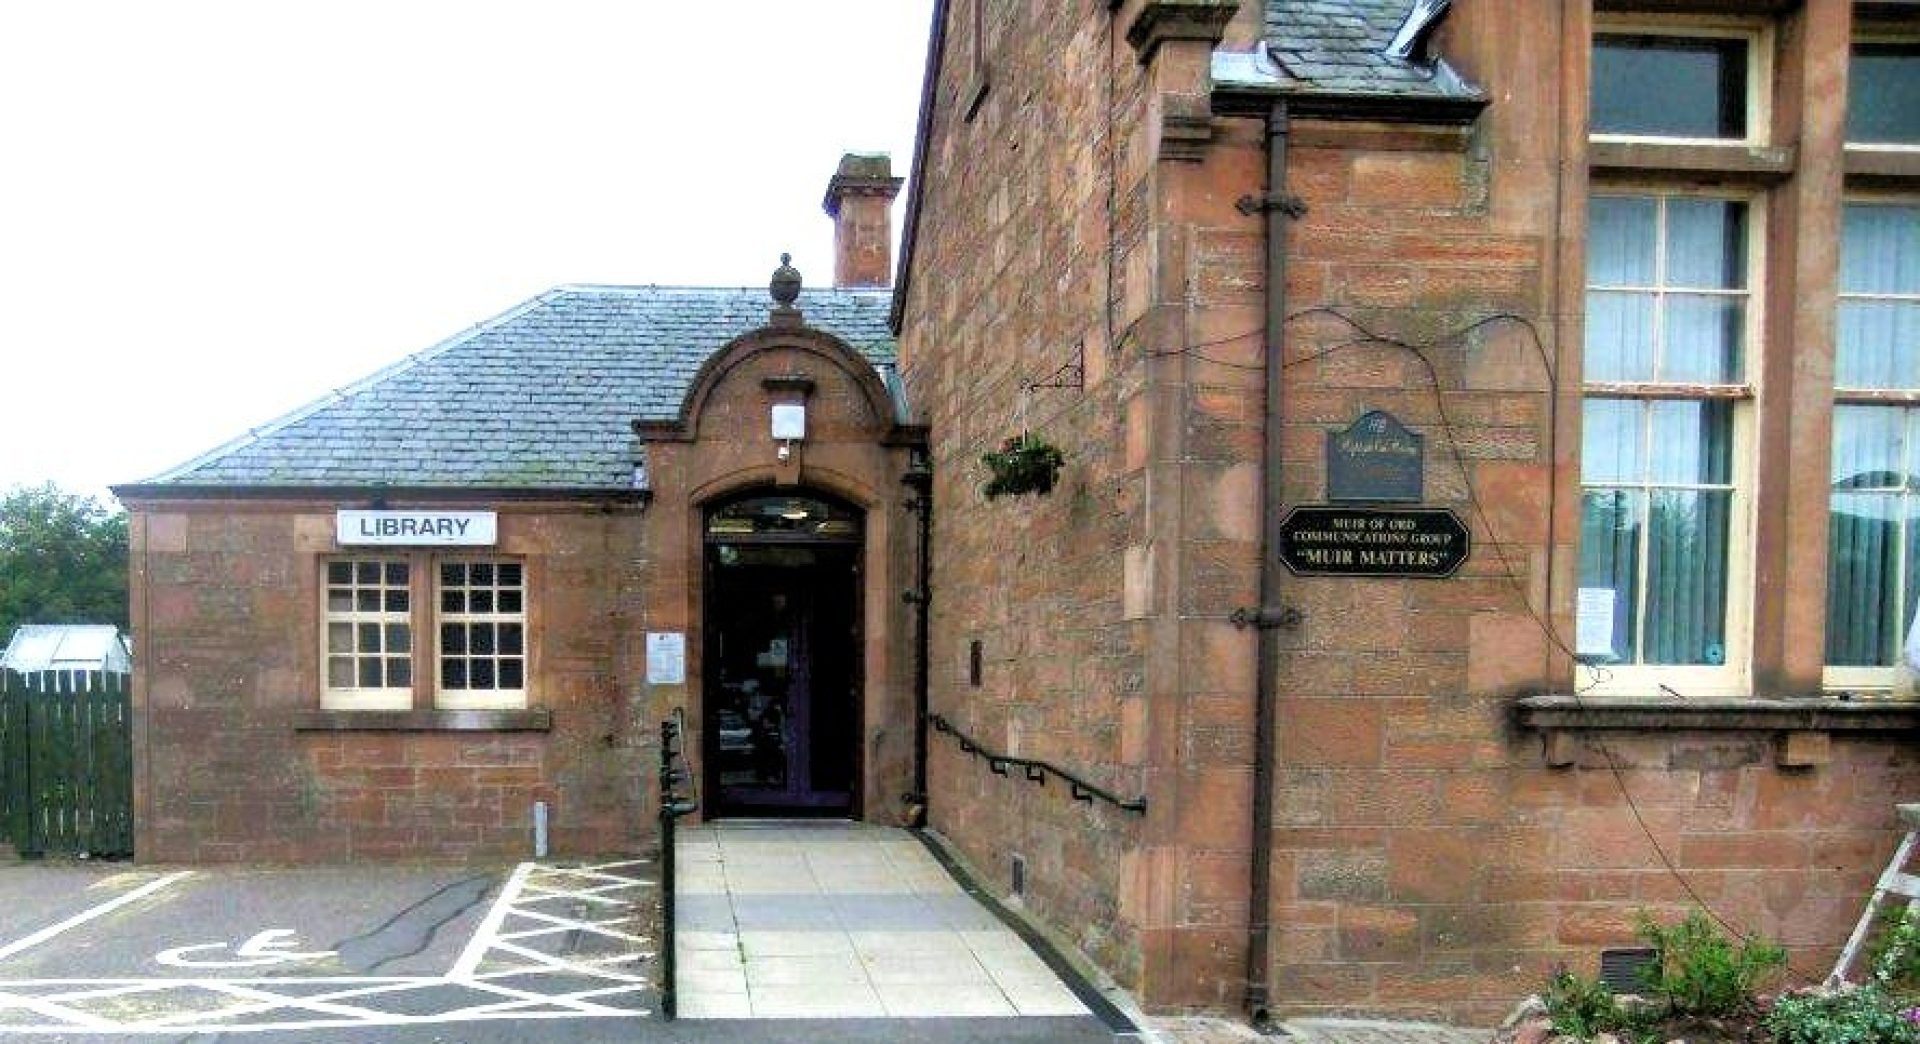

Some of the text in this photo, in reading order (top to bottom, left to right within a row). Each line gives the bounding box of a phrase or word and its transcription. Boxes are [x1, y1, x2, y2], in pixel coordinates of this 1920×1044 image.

[360, 518, 470, 537] LIBRARY
[1333, 518, 1417, 531] MUIR OF ORD
[1293, 531, 1452, 545] COMMUNICATIONS GROUP
[1297, 549, 1448, 566] "MUIR MATTERS"
